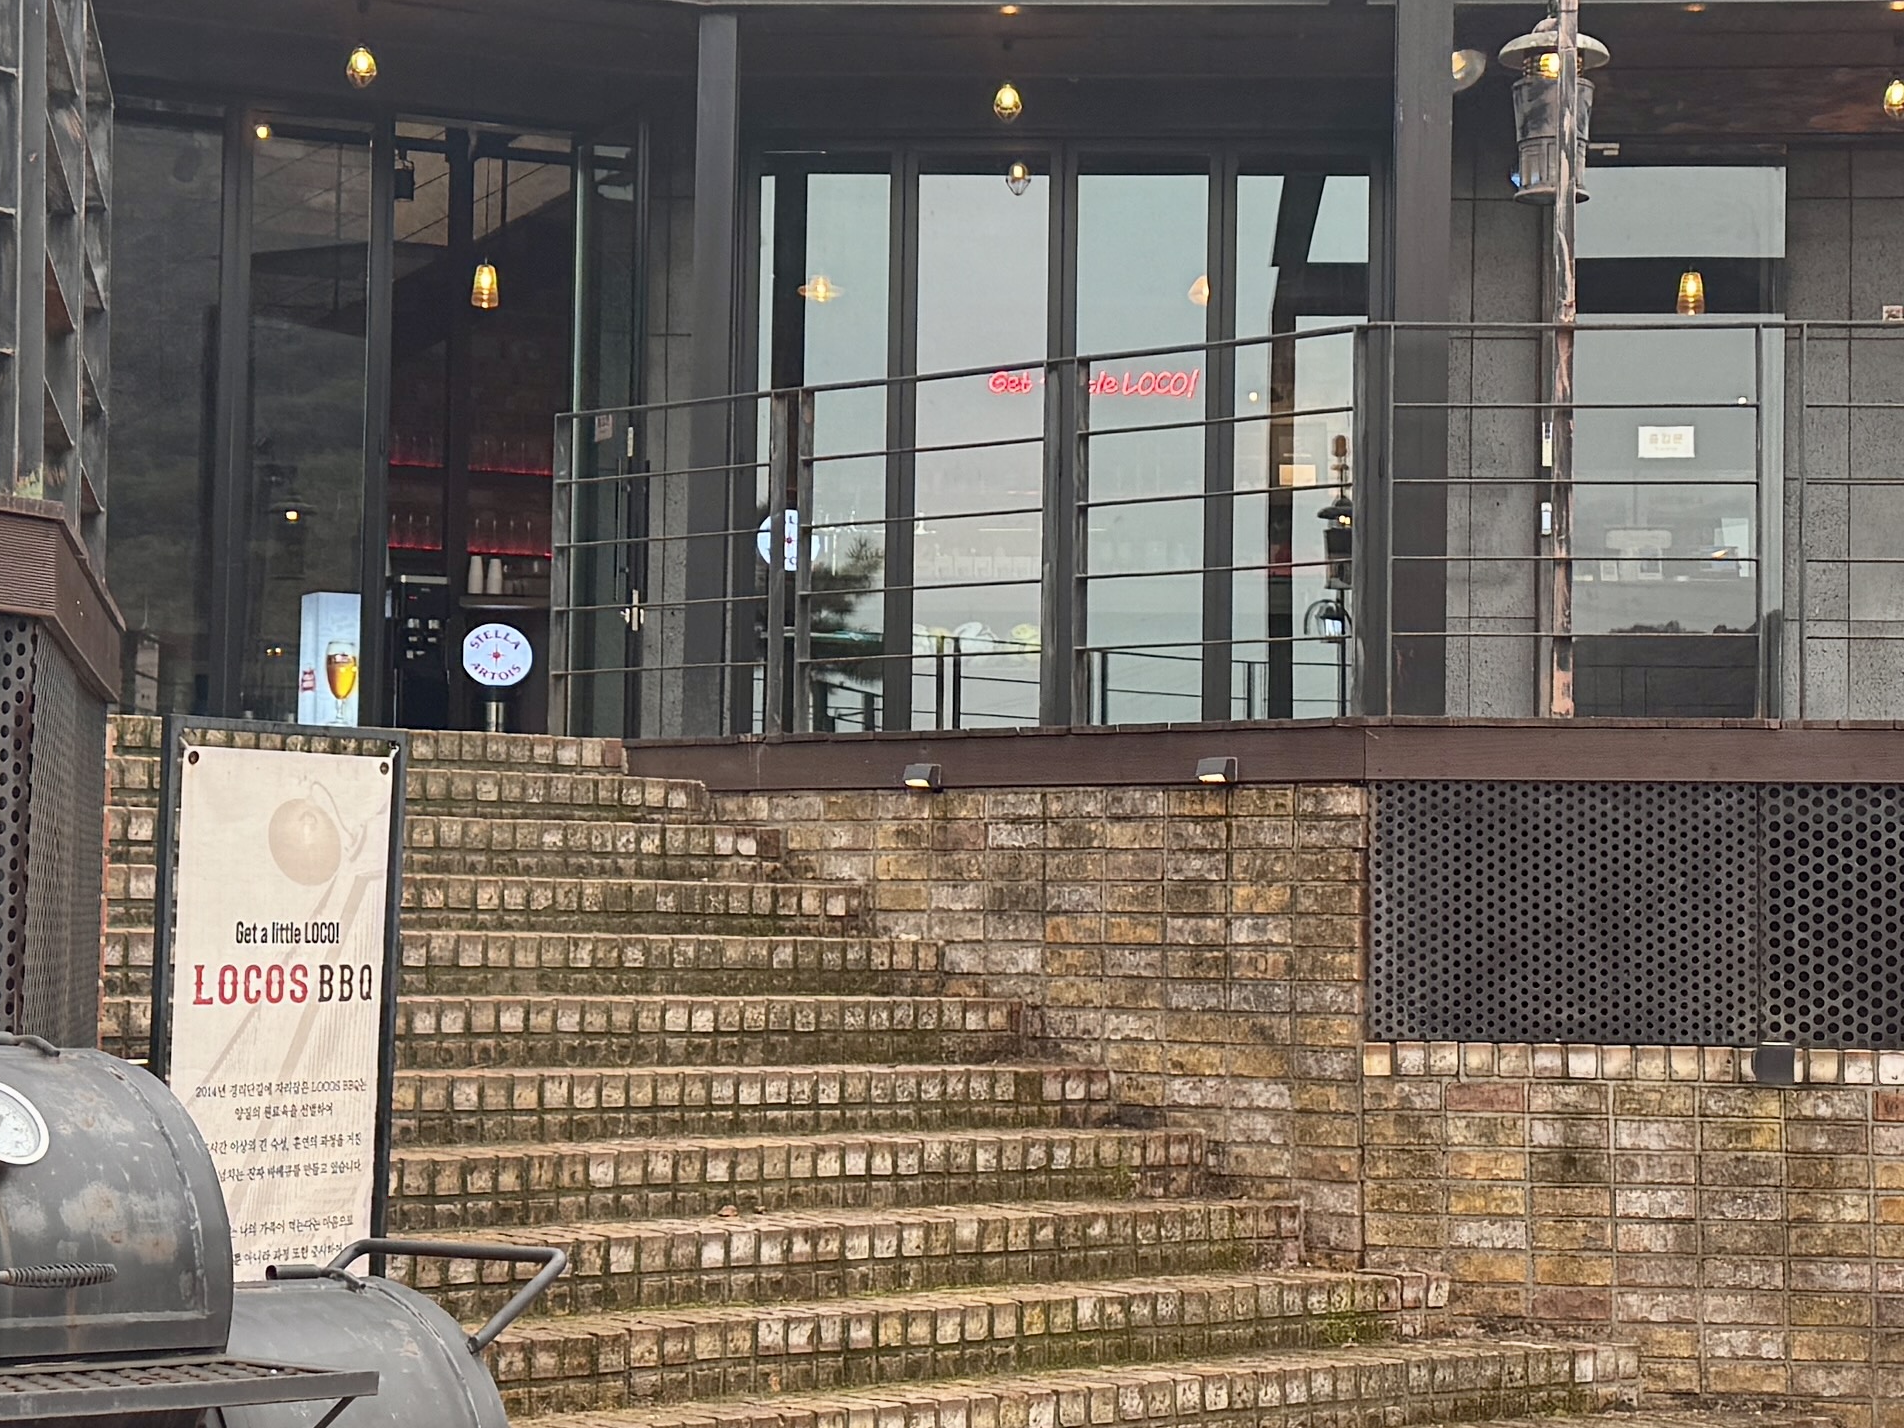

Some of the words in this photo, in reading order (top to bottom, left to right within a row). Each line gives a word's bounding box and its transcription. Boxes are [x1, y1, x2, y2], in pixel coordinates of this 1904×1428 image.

[988, 370, 1032, 394] Get
[1122, 368, 1199, 399] LOCO!
[470, 629, 521, 650] STELLA
[471, 661, 521, 681] ARTOIS
[235, 921, 257, 944] Get
[260, 926, 268, 944] a
[272, 921, 301, 944] little
[304, 921, 340, 944] LOCO!
[193, 964, 308, 1005] LOCOS
[318, 964, 372, 1002] BBQ
[195, 1083, 226, 1098] 2014년
[230, 1082, 272, 1098] 경리단길에
[234, 1106, 261, 1121] 양질의
[205, 1142, 227, 1155] 시간
[230, 1139, 256, 1154] 이상의
[240, 1223, 256, 1237] 나의
